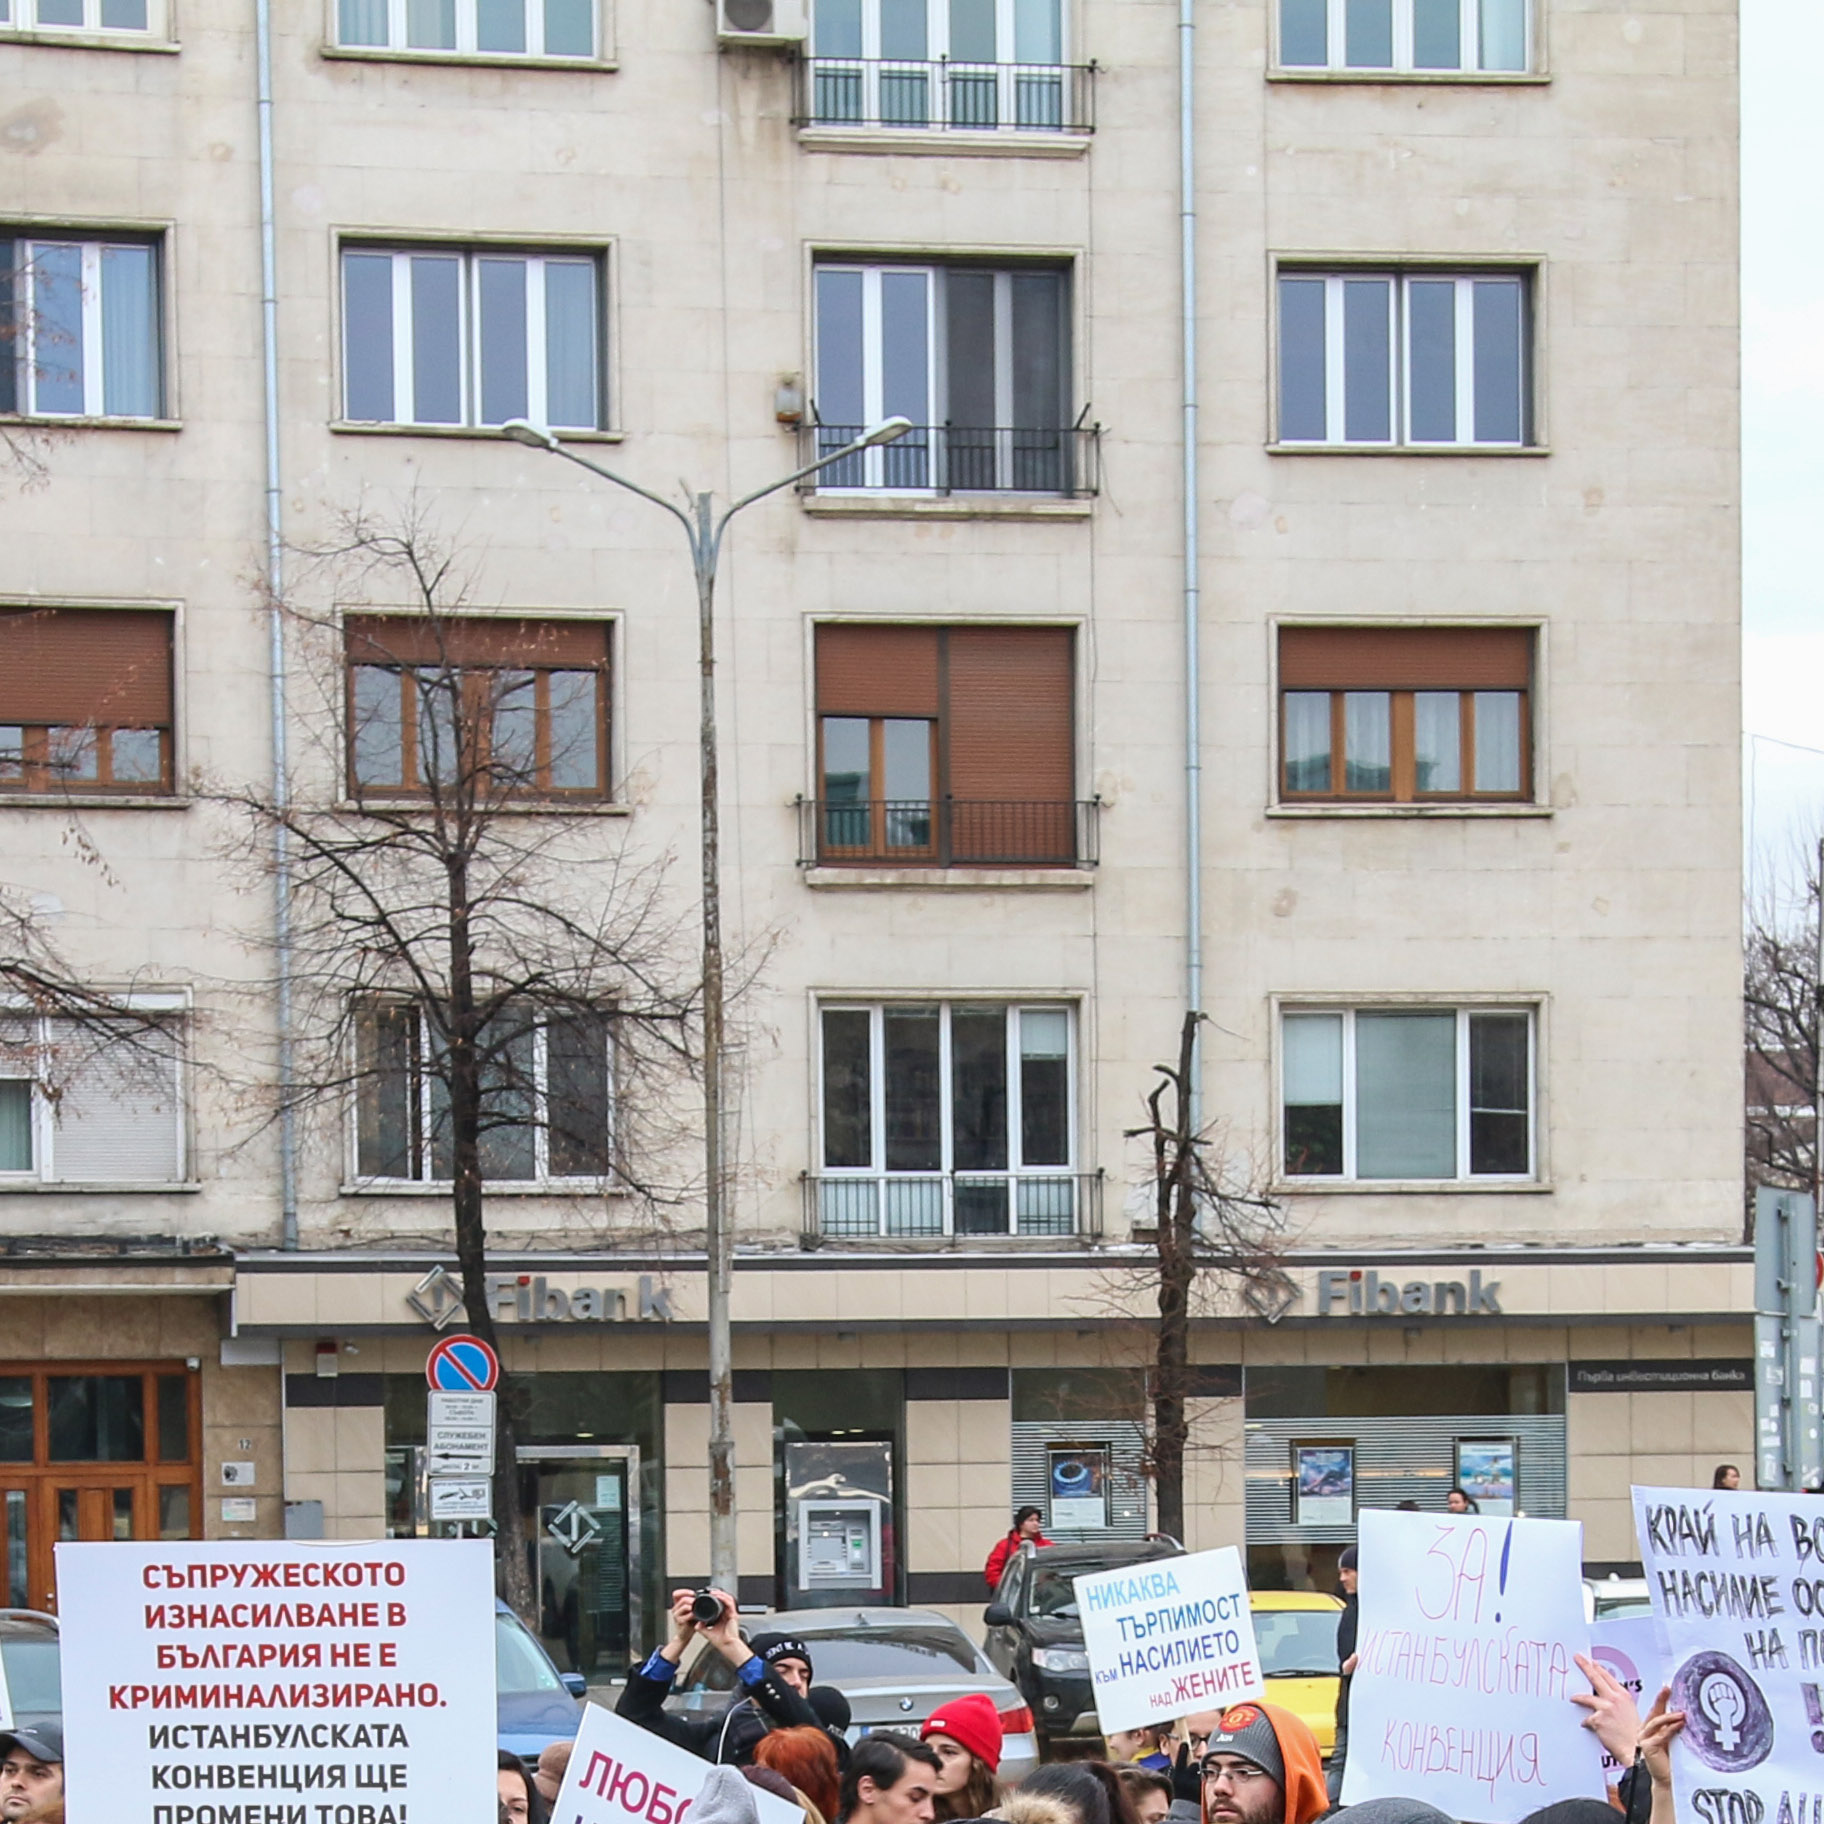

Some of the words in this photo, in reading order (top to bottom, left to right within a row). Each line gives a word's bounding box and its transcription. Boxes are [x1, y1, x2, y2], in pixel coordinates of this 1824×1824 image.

[485, 1275, 673, 1321] Fibank
[1318, 1269, 1502, 1315] Fibank
[433, 1443, 489, 1451] АБОНАМЕНТ
[1645, 1500, 1721, 1558] КРАЙ
[1731, 1511, 1779, 1560] НА
[142, 1562, 406, 1589] СЪПРУЖЕСКОТО
[1085, 1570, 1180, 1612] НИКАКВА
[1657, 1569, 1784, 1621] НАСИЛИЕ
[144, 1602, 379, 1629] ИЗНАСИЛВАНЕ
[387, 1602, 407, 1627] В
[1116, 1592, 1241, 1643] ТЪРПИМОСТ
[157, 1643, 322, 1669] БЪЛГАРИЯ
[330, 1643, 370, 1668] НЕ
[379, 1642, 397, 1667] Е
[1118, 1629, 1240, 1678] НАСИЛИЕТО
[1357, 1625, 1570, 1700] ИСТАНБУЛСКАТА
[1743, 1631, 1789, 1670] НА
[109, 1682, 447, 1710] КРИМИНАЛИЗИРАНО.
[1171, 1660, 1256, 1703] ЖЕНИТЕ
[149, 1723, 410, 1749] ИСТАНБУЛСКАТА
[151, 1764, 346, 1792] КОНВЕНЦИЯ
[354, 1764, 408, 1792] ЩЕ
[1381, 1718, 1547, 1803] КОНВЕНЦИЯ
